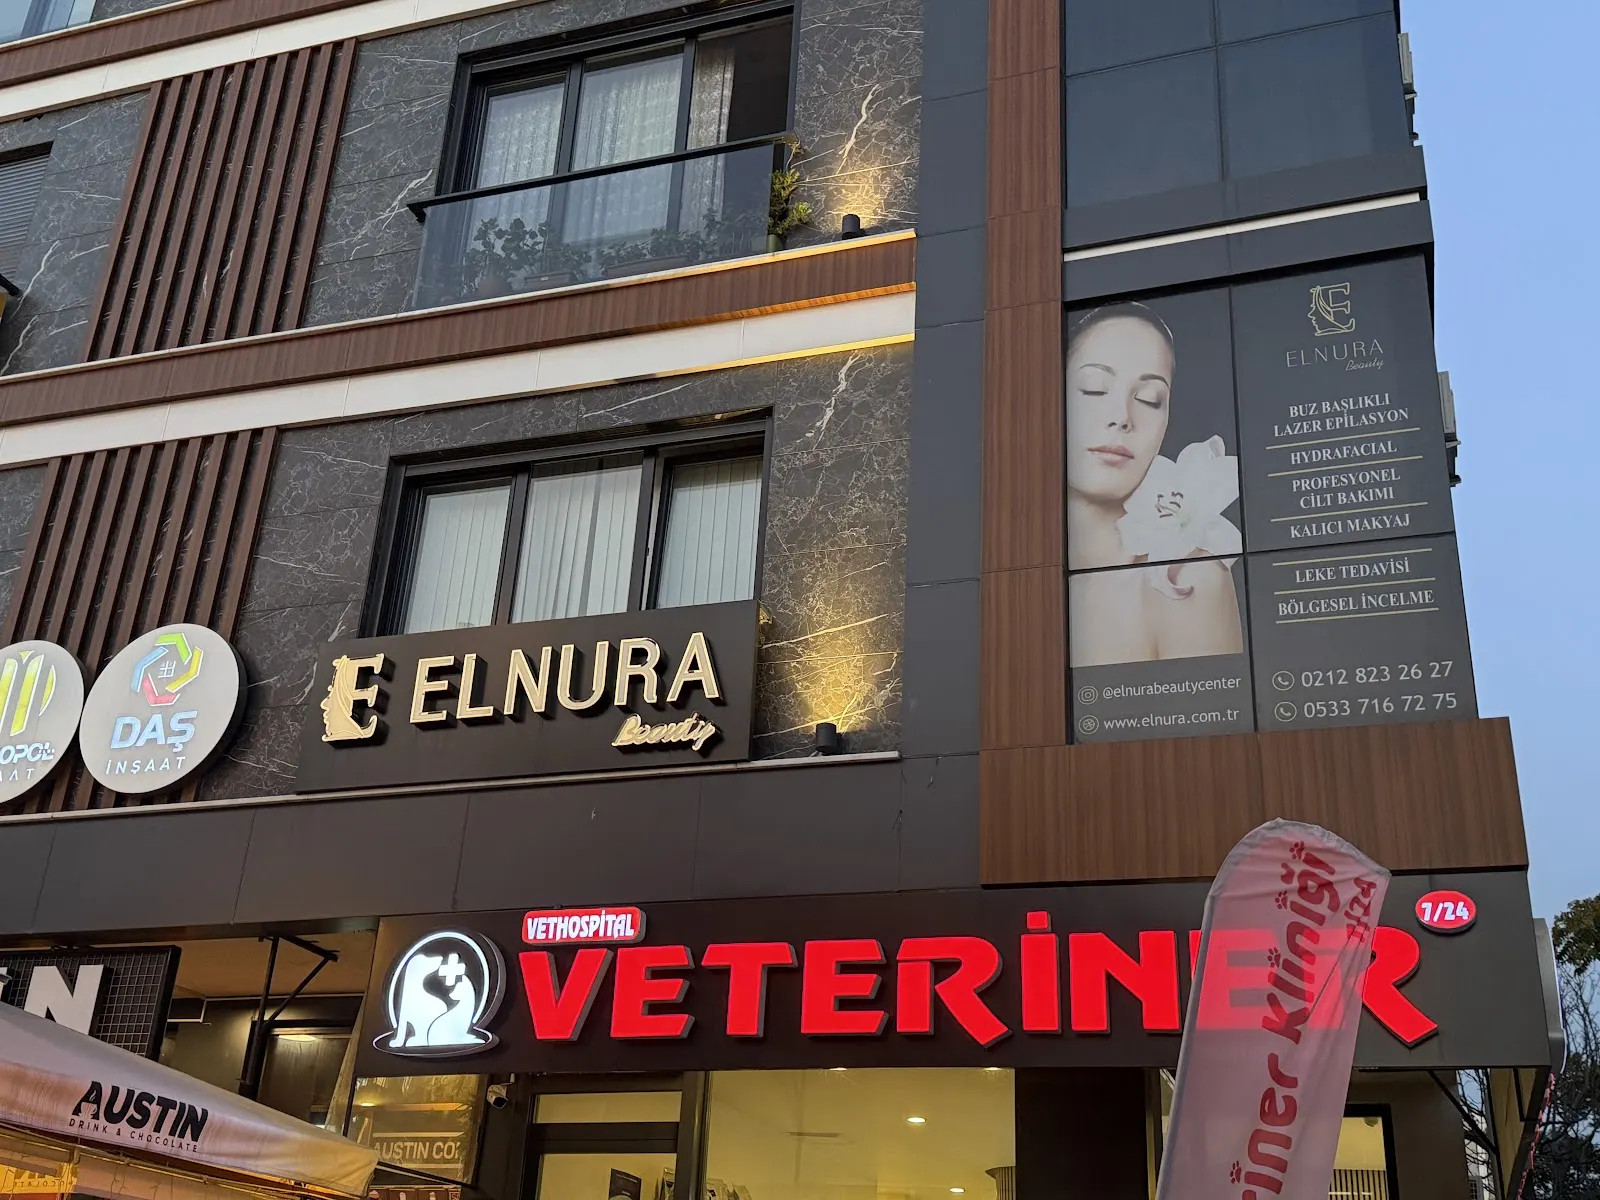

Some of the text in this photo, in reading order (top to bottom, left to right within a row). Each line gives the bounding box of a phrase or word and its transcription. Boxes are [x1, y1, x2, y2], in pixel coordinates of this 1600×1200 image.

[1286, 339, 1384, 368] ELNURA
[1345, 357, 1385, 372] Beauty
[1289, 393, 1391, 418] BUZ BAŞLIKLI
[1274, 408, 1409, 437] LAZER EPİLASYON
[1290, 440, 1398, 465] HYDRAFACIAL
[1292, 468, 1401, 492] PROFESYONEL
[1300, 486, 1395, 509] CİLT BAKIMI
[1290, 513, 1411, 539] KALICI MAKYAJ
[1296, 557, 1411, 583] LEKE TEDAVİSİ
[1278, 589, 1435, 616] BÖLGESEL İNCELME
[409, 631, 721, 725] ELNURA
[1301, 661, 1453, 687] 0212 823 26 27
[1103, 677, 1242, 699] @elnurabeautycenter
[1304, 692, 1458, 718] 0533 716 72 75
[110, 709, 199, 753] DAŞ
[611, 711, 717, 752] Beauty
[1104, 709, 1240, 730] www.elnura.com.tr
[105, 756, 186, 775] İNŞAAT
[1420, 900, 1470, 924] 7/24
[526, 909, 635, 942] VETHOSPİTAL
[518, 911, 1439, 1045] VETERİNER
[71, 1080, 209, 1142] AUSTIN
[69, 1117, 109, 1134] DRINK
[129, 1130, 199, 1153] CHOCOLATE
[374, 1141, 430, 1159] AUSTIN
